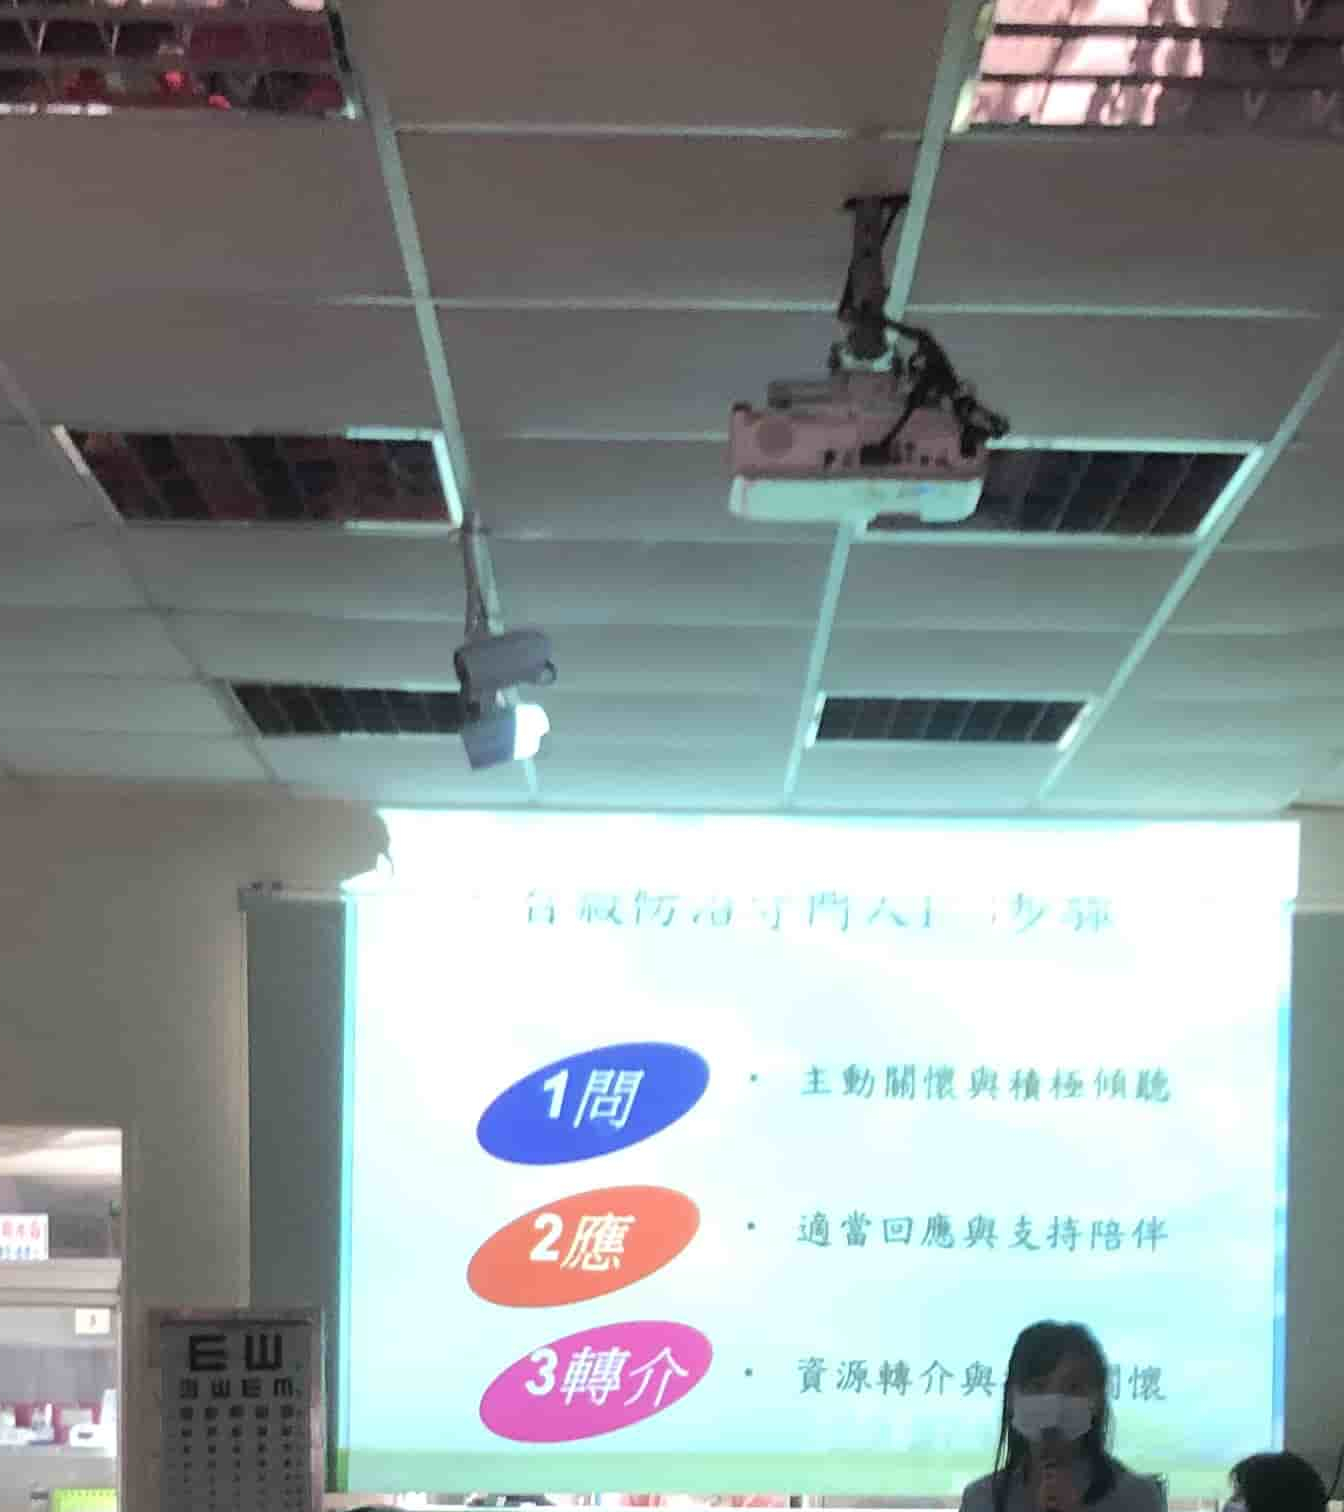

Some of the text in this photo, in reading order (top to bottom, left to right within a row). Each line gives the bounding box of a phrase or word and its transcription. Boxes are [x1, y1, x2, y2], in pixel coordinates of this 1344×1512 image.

[542, 1068, 645, 1129] 1問
[801, 1064, 1171, 1102] 主動關懷與積極傾聽
[529, 1212, 635, 1272] 2應
[797, 1210, 1169, 1252] 適當回應與支持陪伴
[524, 1346, 689, 1407] 3轉介
